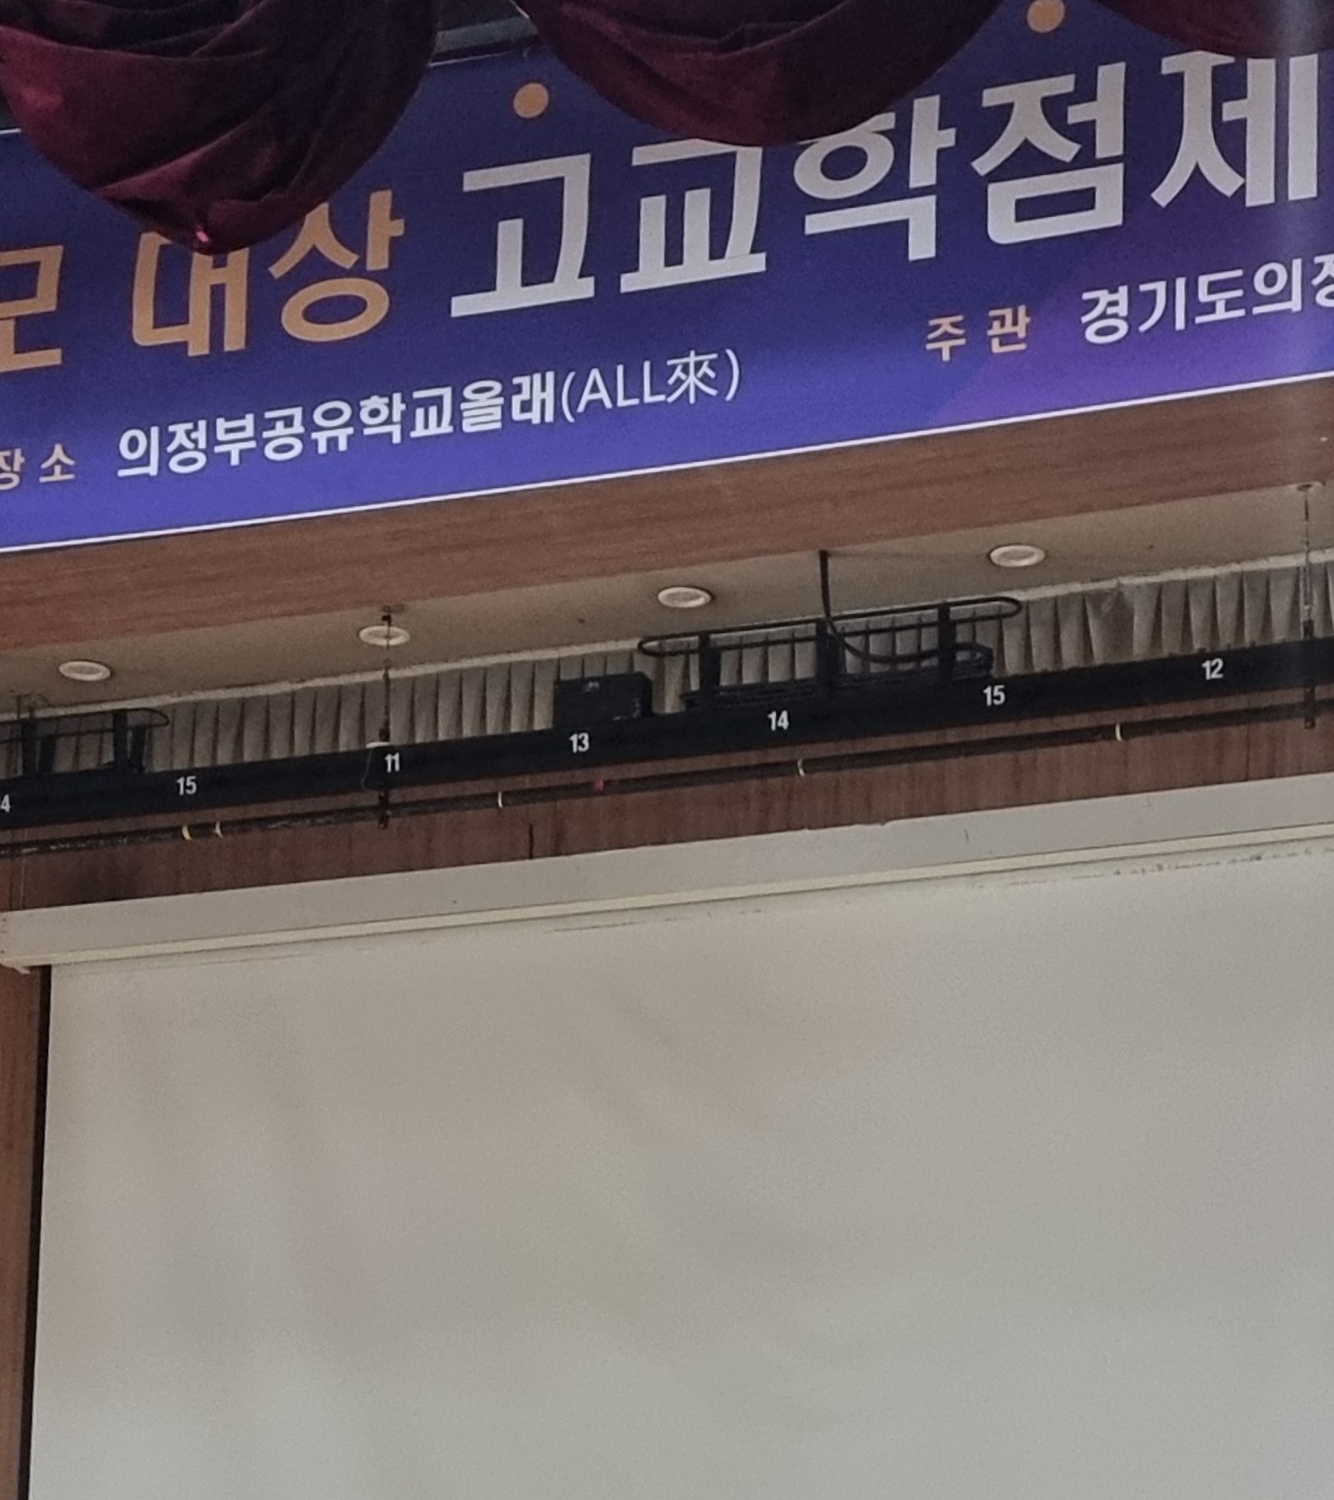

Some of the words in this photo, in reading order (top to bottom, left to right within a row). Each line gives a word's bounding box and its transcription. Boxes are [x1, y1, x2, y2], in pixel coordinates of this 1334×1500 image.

[131, 189, 405, 357] 대상
[450, 50, 1319, 318] 고교학점제
[1201, 657, 1224, 681] 12
[983, 684, 1006, 707] 15
[767, 710, 789, 731] 14
[569, 732, 590, 753] 13
[384, 752, 400, 773] 11
[176, 775, 197, 796] 15
